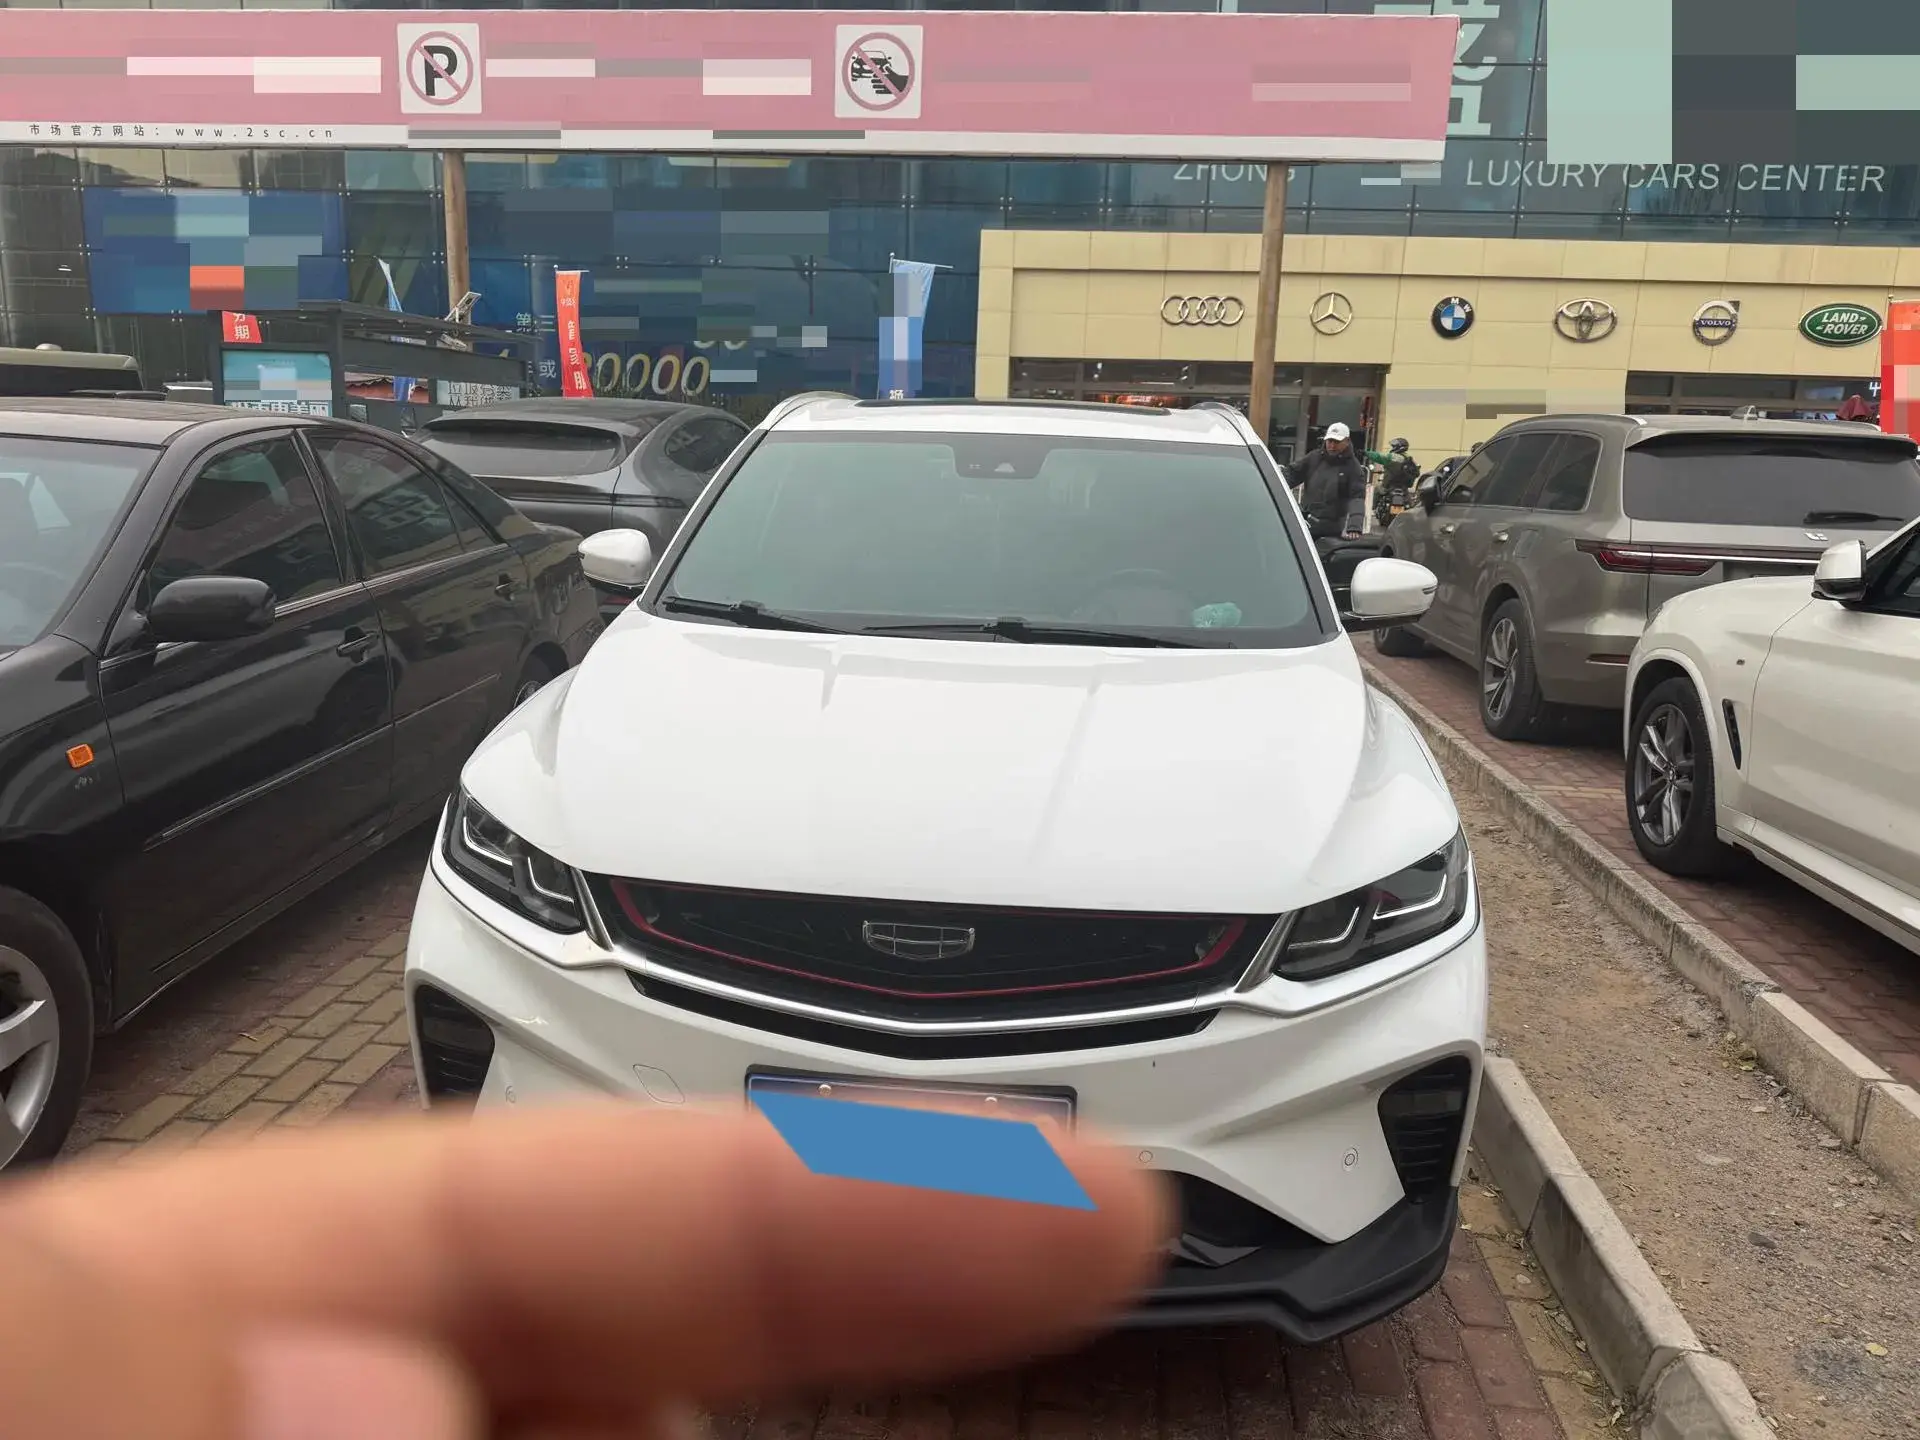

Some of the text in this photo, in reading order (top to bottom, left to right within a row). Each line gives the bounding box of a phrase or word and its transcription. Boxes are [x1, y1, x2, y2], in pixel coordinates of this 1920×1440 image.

[424, 45, 458, 96] P
[1466, 160, 1886, 193] LUXURY CARS CENTER
[1700, 319, 1732, 327] VOLVO
